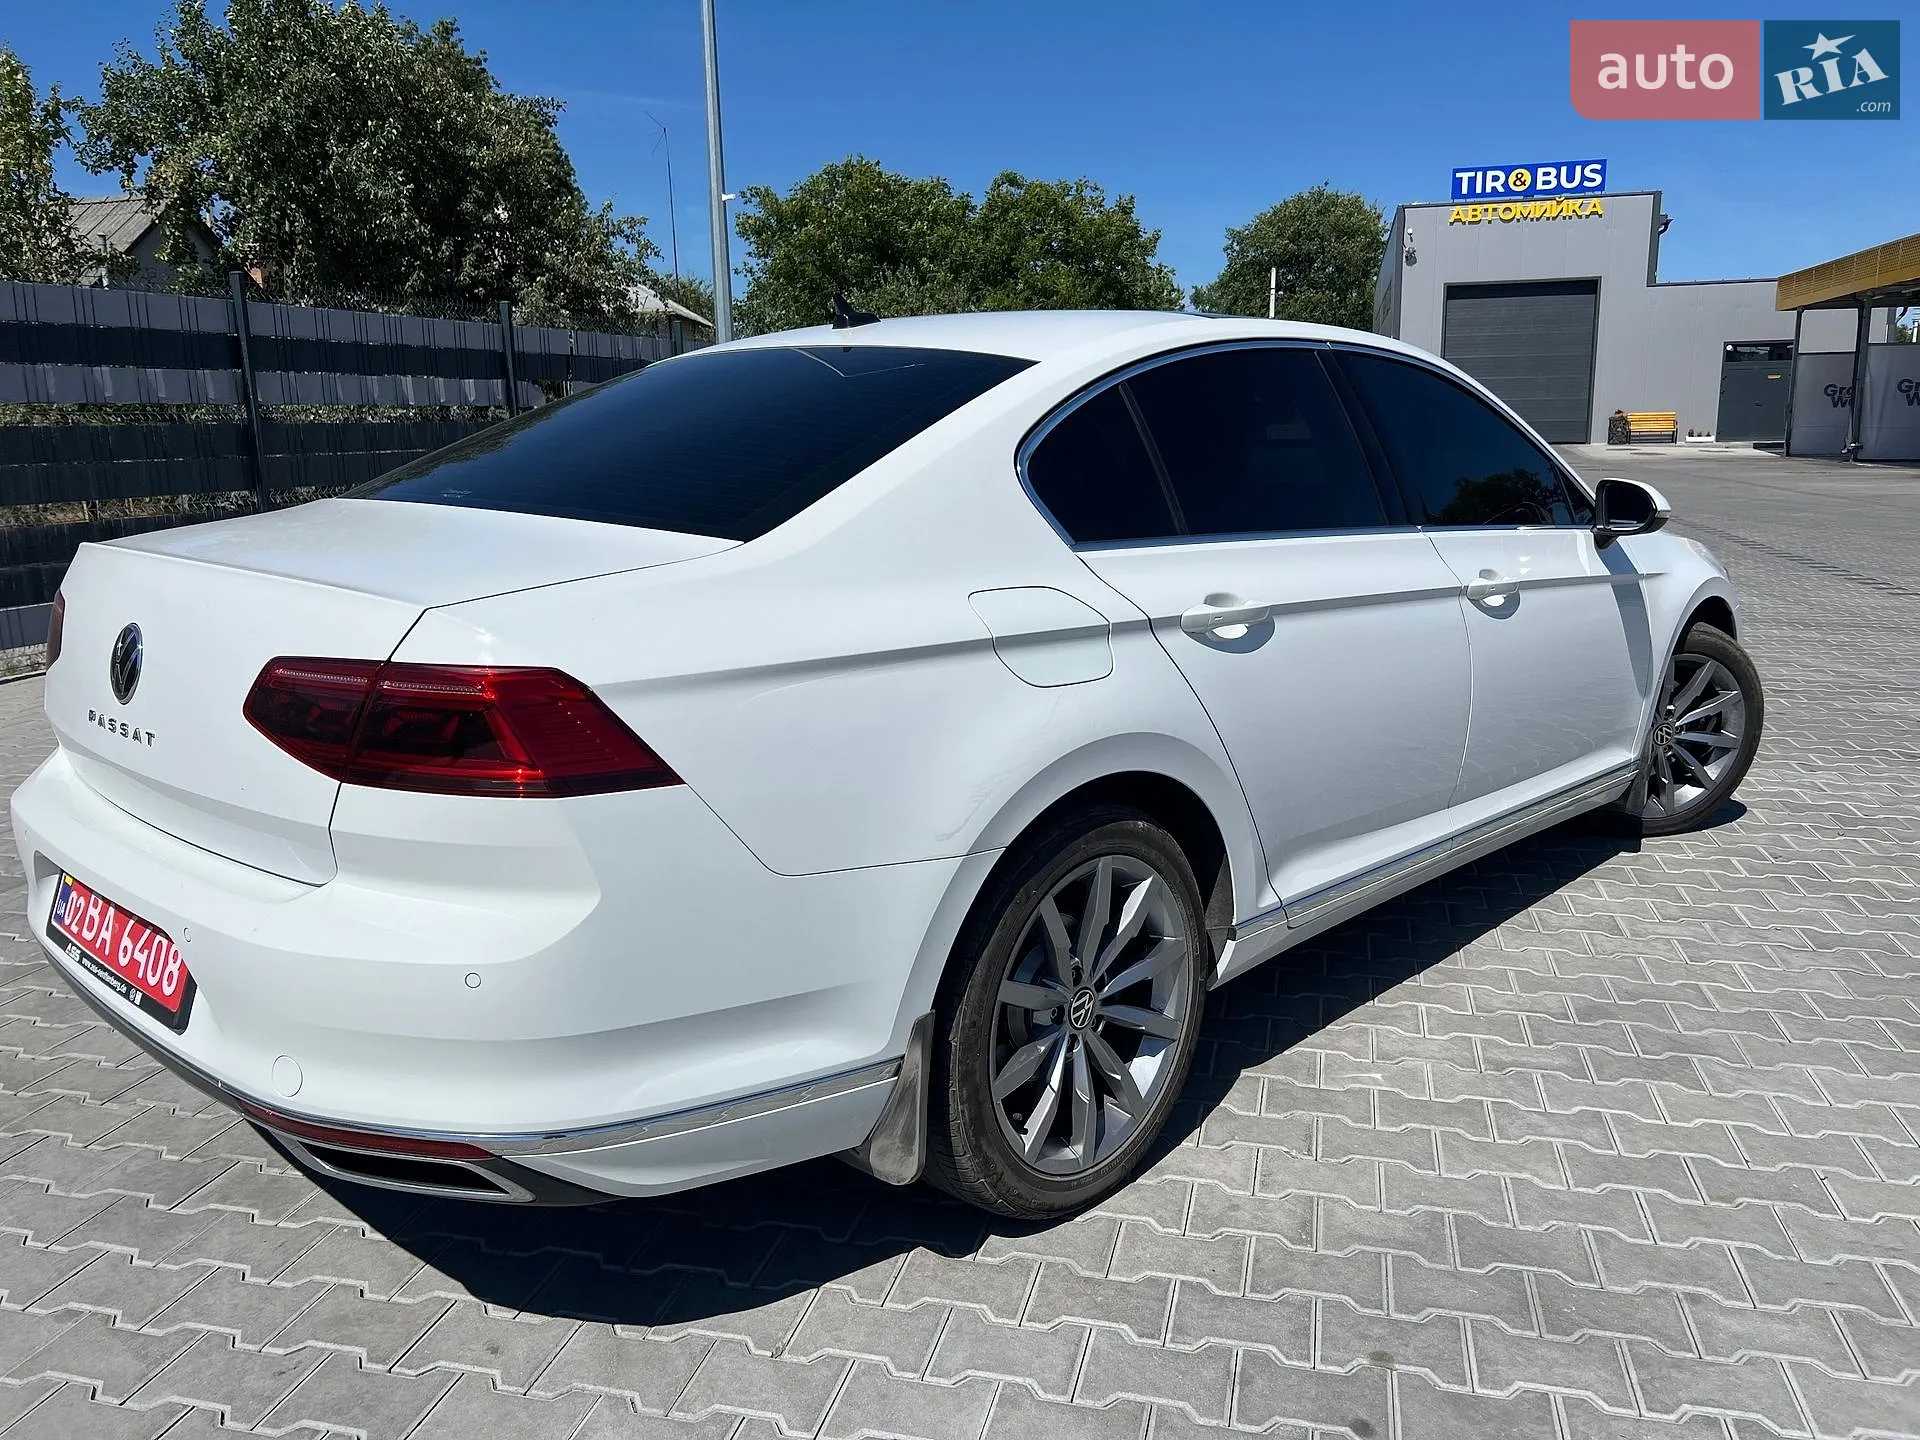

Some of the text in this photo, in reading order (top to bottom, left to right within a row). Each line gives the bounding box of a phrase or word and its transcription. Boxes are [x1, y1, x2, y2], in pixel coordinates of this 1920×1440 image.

[1455, 170, 1505, 194] TIR
[1536, 163, 1603, 191] BUS
[1449, 196, 1604, 223] АВТОМИЙКА
[87, 709, 156, 747] PASSAT
[117, 919, 183, 997] 6408
